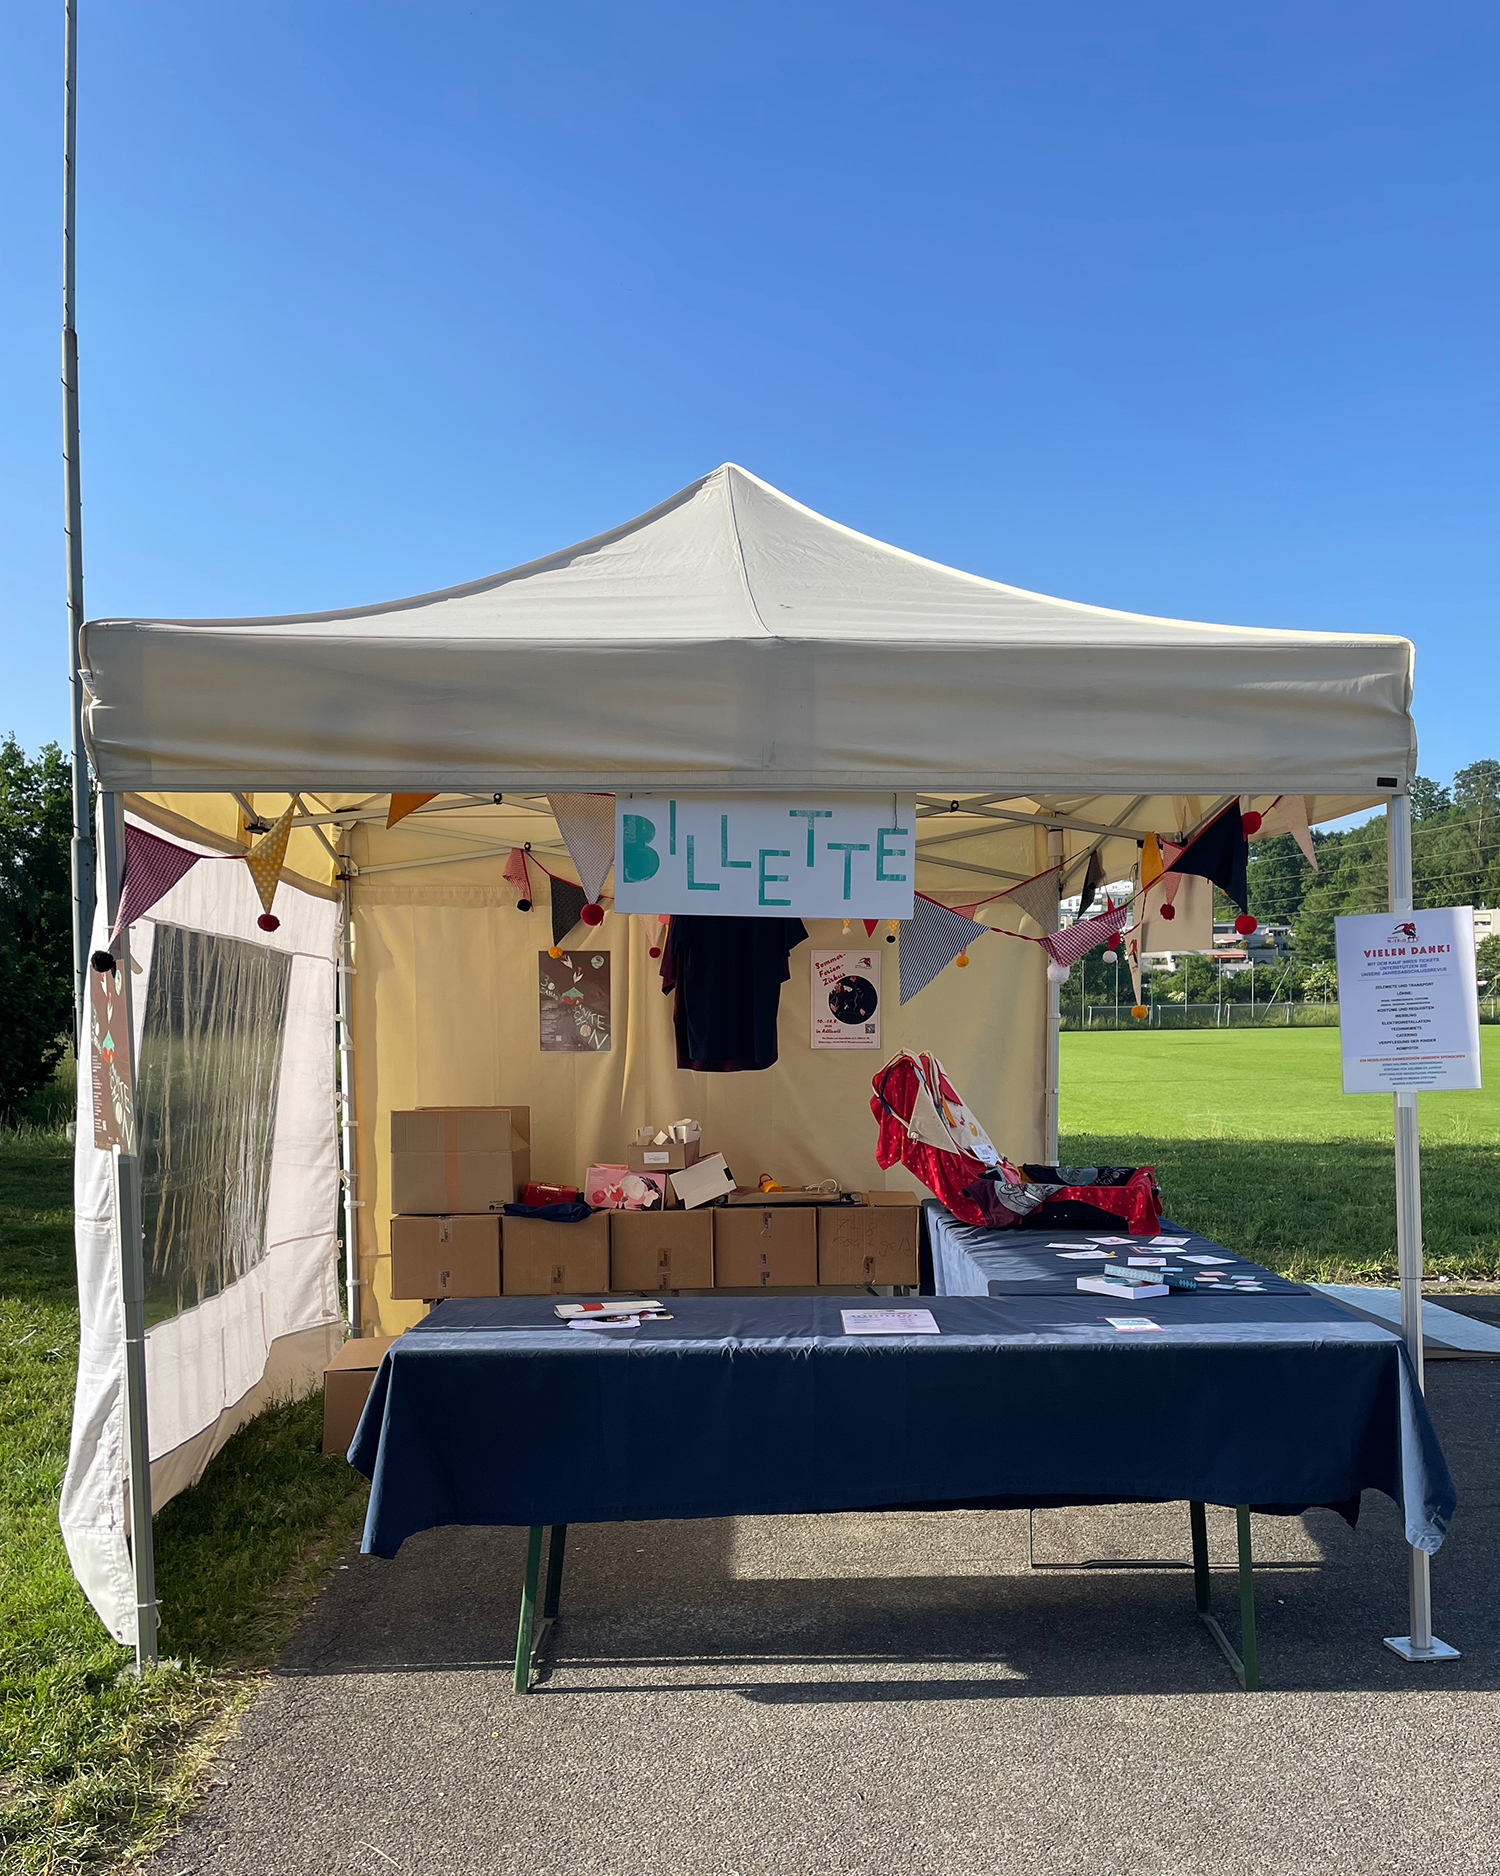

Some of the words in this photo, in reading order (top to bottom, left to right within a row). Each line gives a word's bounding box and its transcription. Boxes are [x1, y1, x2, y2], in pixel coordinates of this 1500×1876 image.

[623, 800, 908, 906] BILLETTE
[1364, 948, 1405, 958] VIELEN
[1411, 944, 1450, 955] DANK!
[814, 953, 846, 970] Sommer-
[818, 964, 844, 978] Ferien-
[822, 973, 846, 986] Zirkus
